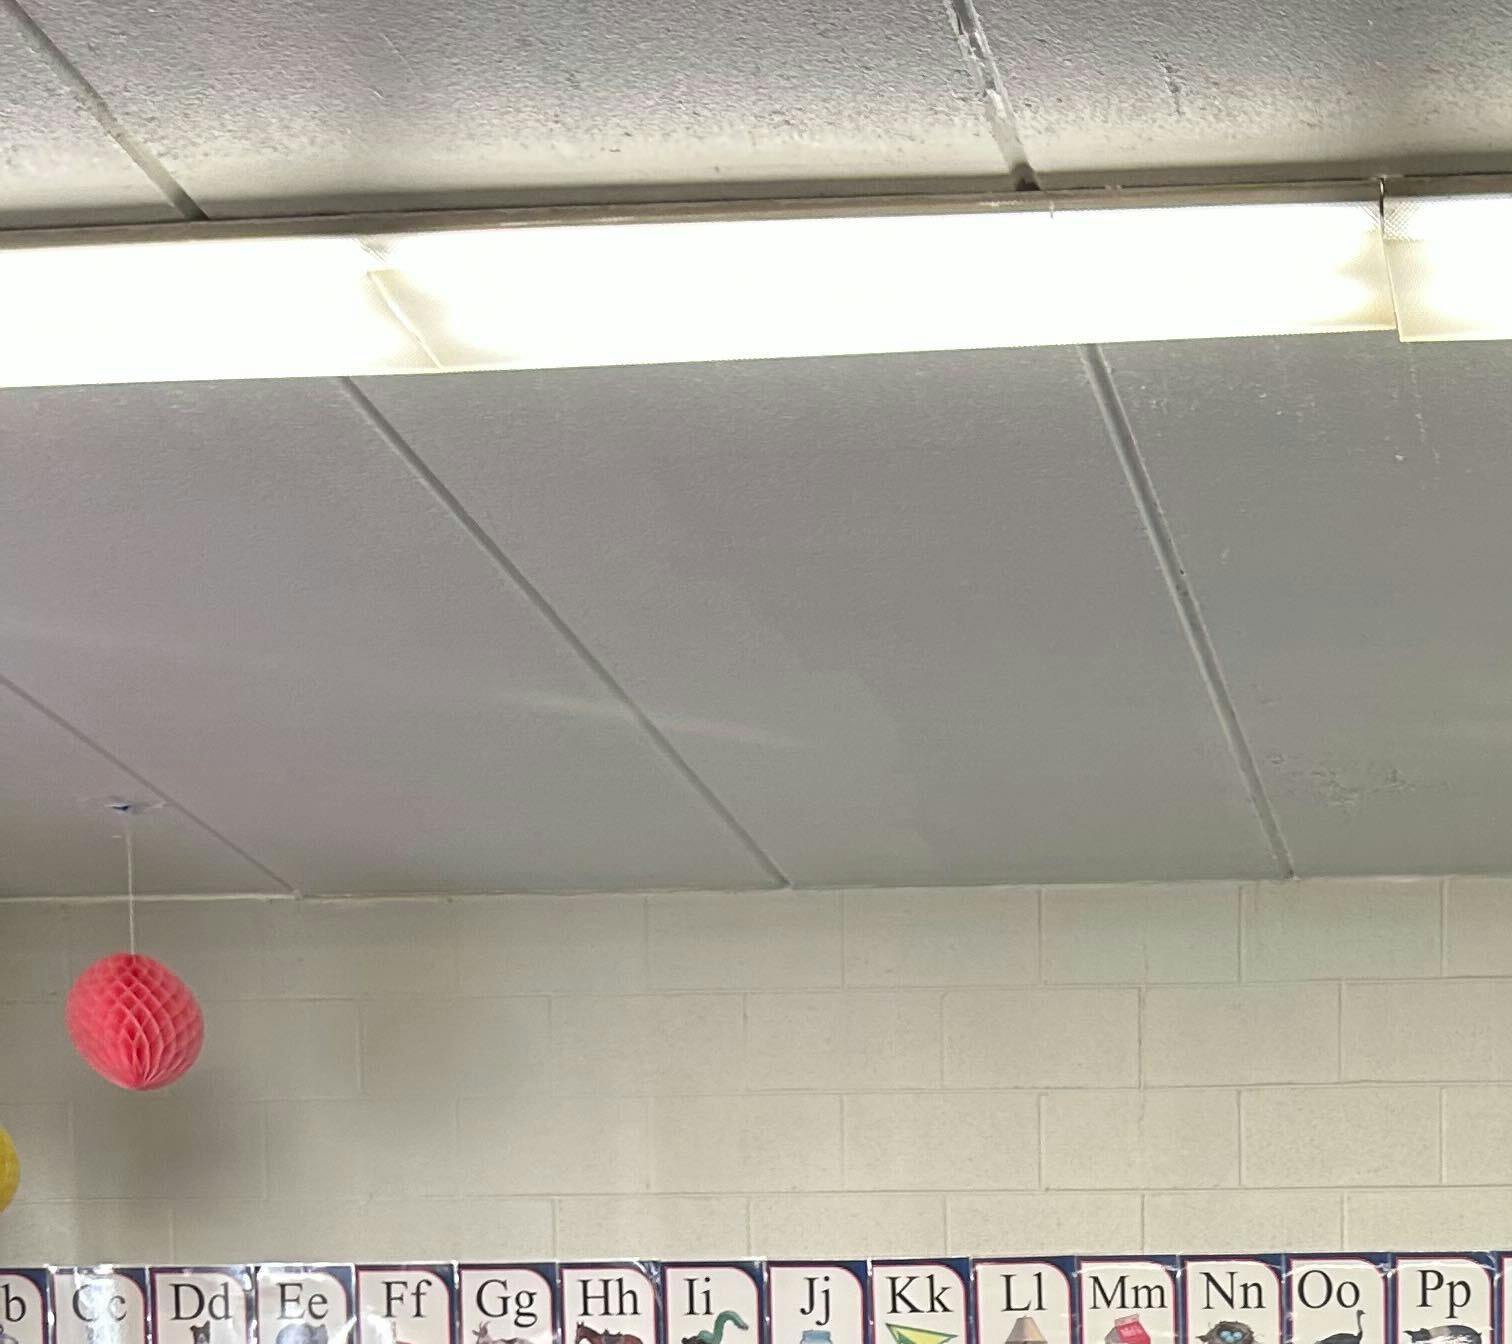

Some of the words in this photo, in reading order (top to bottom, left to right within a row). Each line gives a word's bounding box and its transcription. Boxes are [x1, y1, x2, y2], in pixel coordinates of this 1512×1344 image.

[0, 1285, 26, 1321] b
[170, 1282, 233, 1322] Dd
[277, 1282, 330, 1321] Ee
[382, 1279, 433, 1319] Ff
[475, 1278, 538, 1327] Gg
[578, 1278, 640, 1316] Hh
[684, 1276, 712, 1316] Ii
[800, 1276, 831, 1326] Jj
[886, 1276, 952, 1314] Kk
[1001, 1273, 1045, 1312] Ll
[1089, 1273, 1168, 1311] Mm
[1201, 1271, 1266, 1311] Nn
[1299, 1268, 1361, 1309] Oo
[1417, 1269, 1472, 1319] Pp
